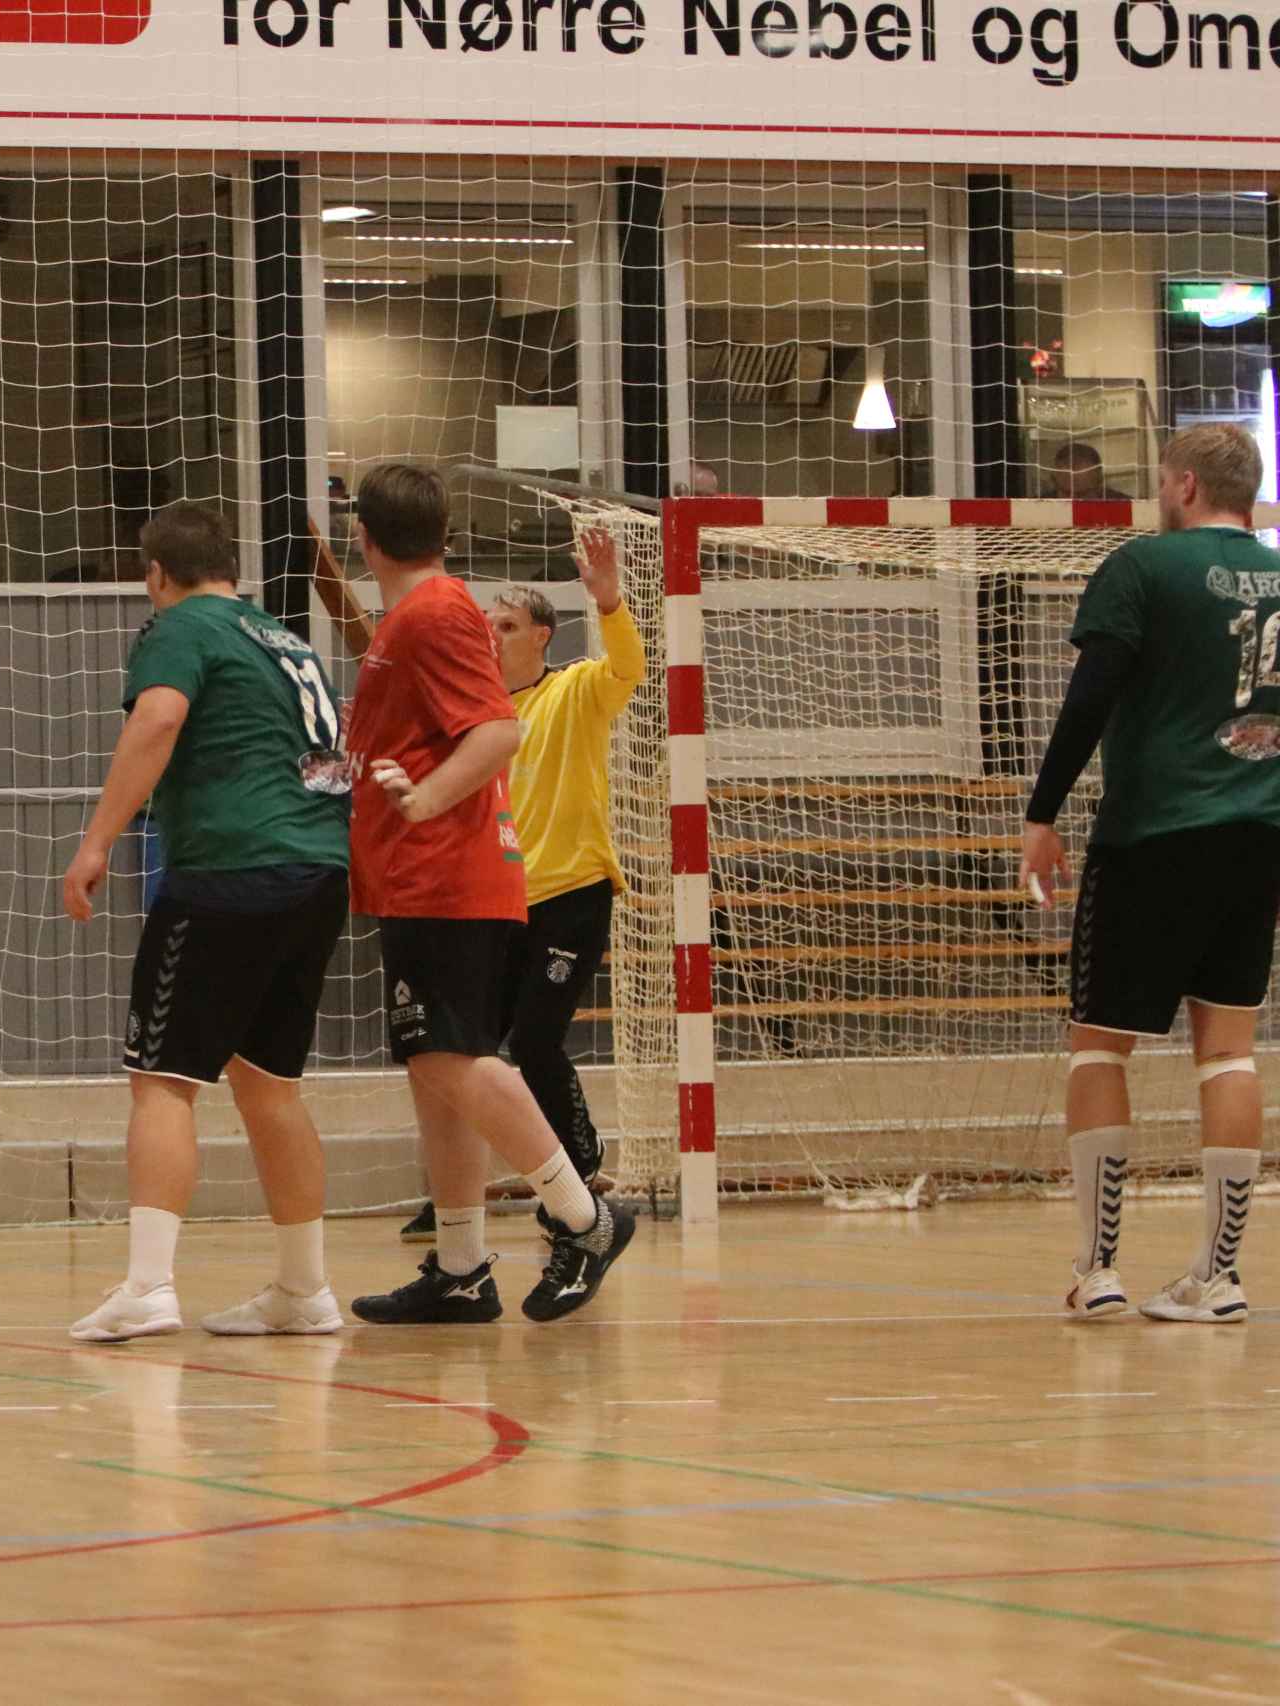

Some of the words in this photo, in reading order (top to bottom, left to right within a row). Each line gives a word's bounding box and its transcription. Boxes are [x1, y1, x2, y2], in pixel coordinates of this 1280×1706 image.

[387, 0, 646, 55] Nørre
[682, 0, 937, 62] Nebel
[971, 3, 1079, 87] og
[1114, 0, 1280, 71] Om
